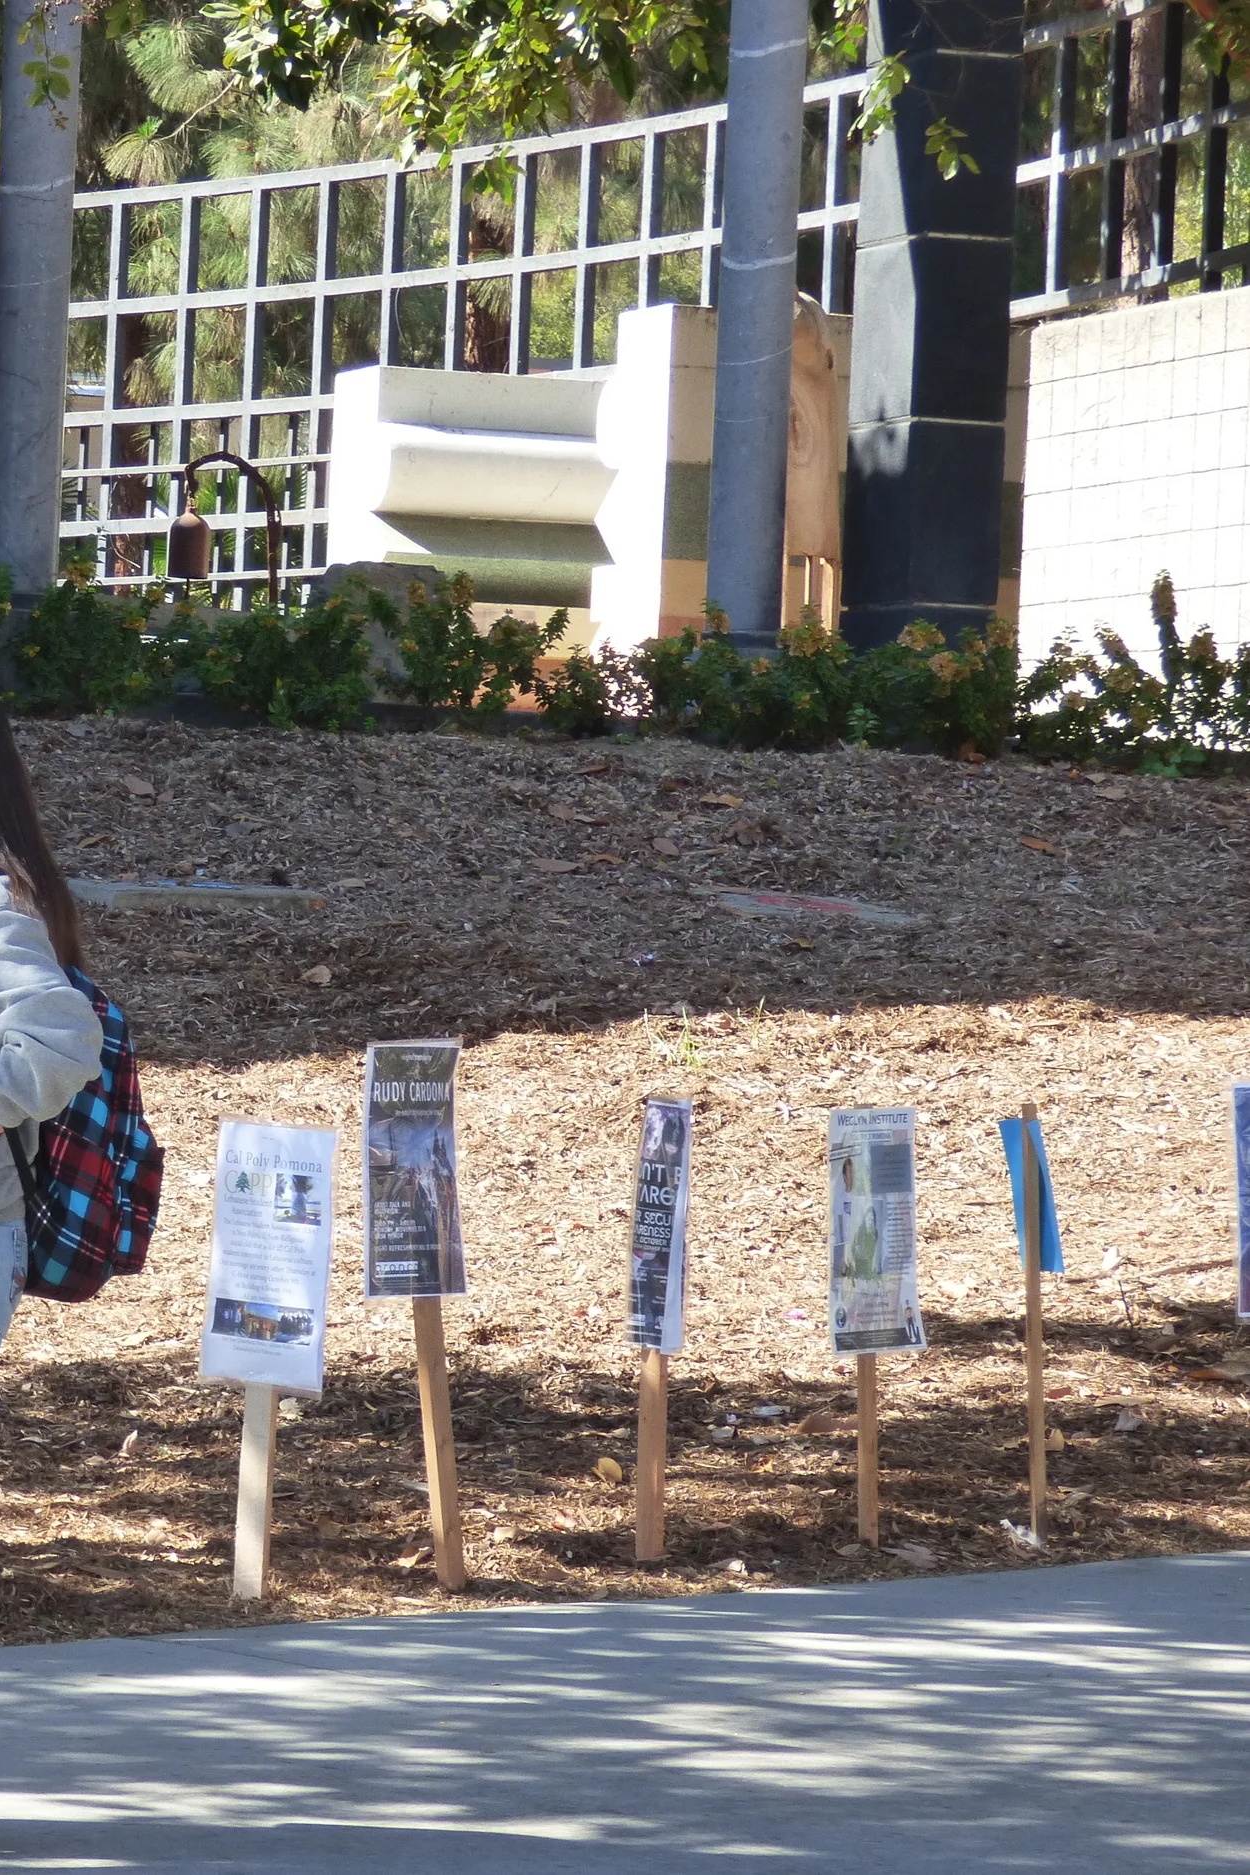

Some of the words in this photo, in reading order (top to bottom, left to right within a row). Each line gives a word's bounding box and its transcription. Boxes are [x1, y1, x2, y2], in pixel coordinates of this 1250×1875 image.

[374, 1081, 406, 1102] RUDY
[409, 1081, 450, 1102] CARDONA
[869, 1112, 908, 1125] INSTITUTE
[225, 1149, 242, 1166] Cal
[246, 1151, 271, 1170] Poly
[274, 1154, 323, 1174] Pomona
[644, 1211, 672, 1226] SECU
